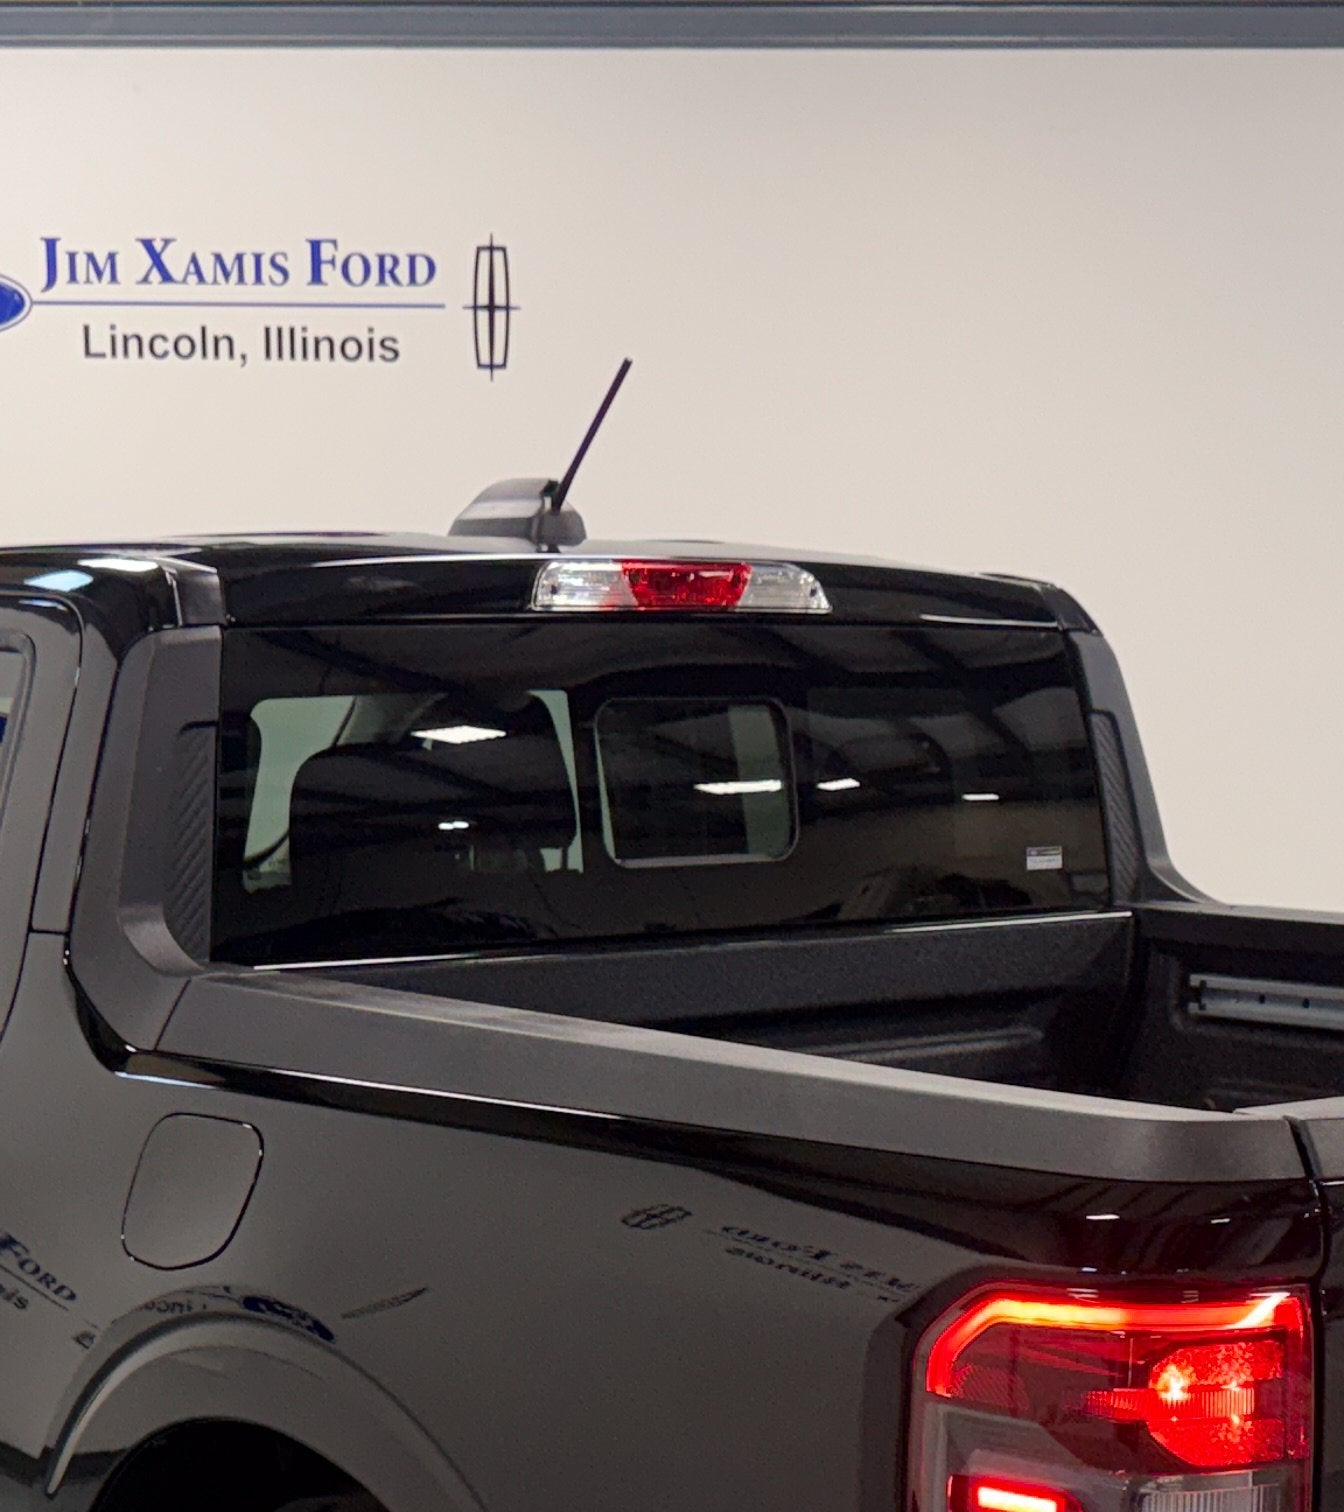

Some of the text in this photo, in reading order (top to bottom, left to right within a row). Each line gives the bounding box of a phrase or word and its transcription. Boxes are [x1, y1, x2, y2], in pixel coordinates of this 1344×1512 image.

[40, 237, 437, 292] JIM XAMIS FORD
[83, 324, 400, 368] Lincoln, Illinois
